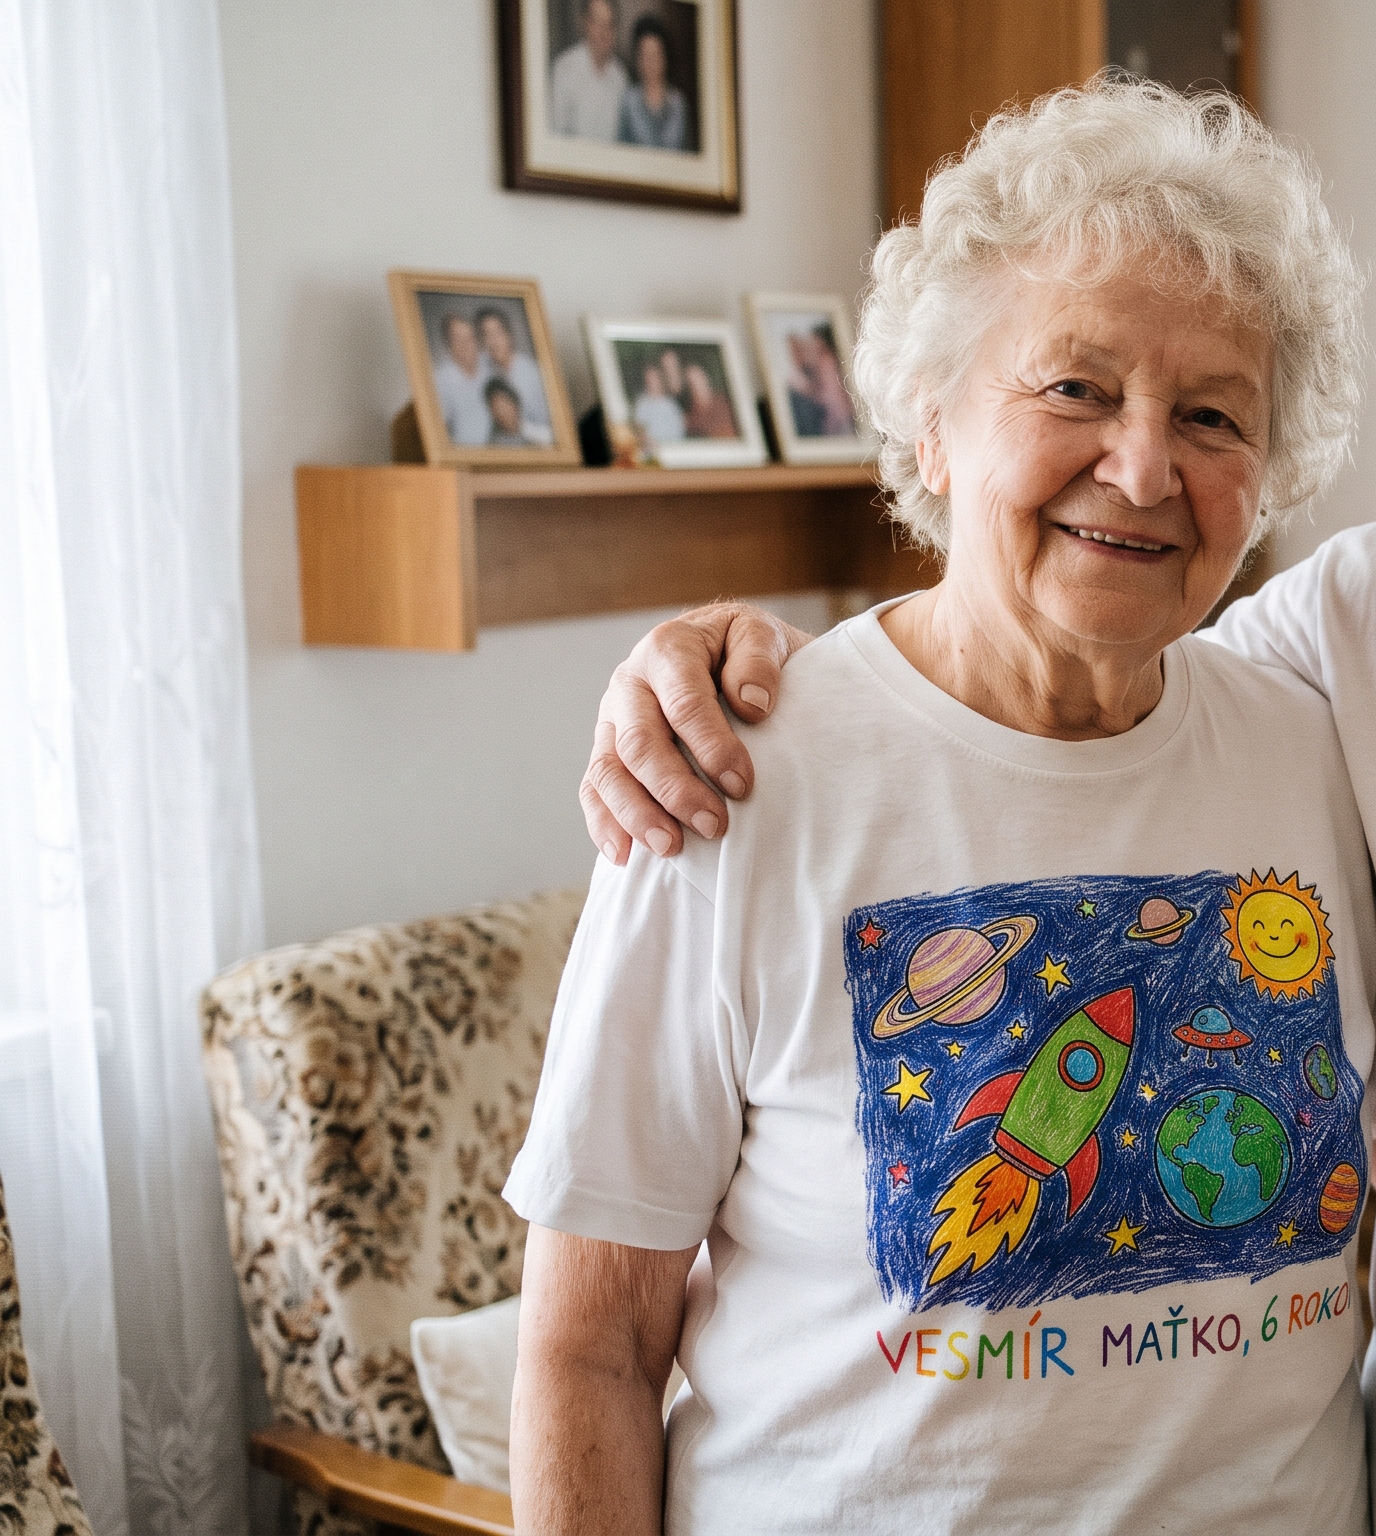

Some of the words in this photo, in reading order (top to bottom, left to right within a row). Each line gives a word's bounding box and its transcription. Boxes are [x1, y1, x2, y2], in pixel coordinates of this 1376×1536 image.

[876, 1310, 1075, 1380] VESMÍR
[1102, 1305, 1250, 1368] MAŤKO,
[1261, 1294, 1279, 1342] 6
[1287, 1281, 1351, 1335] ROKO
